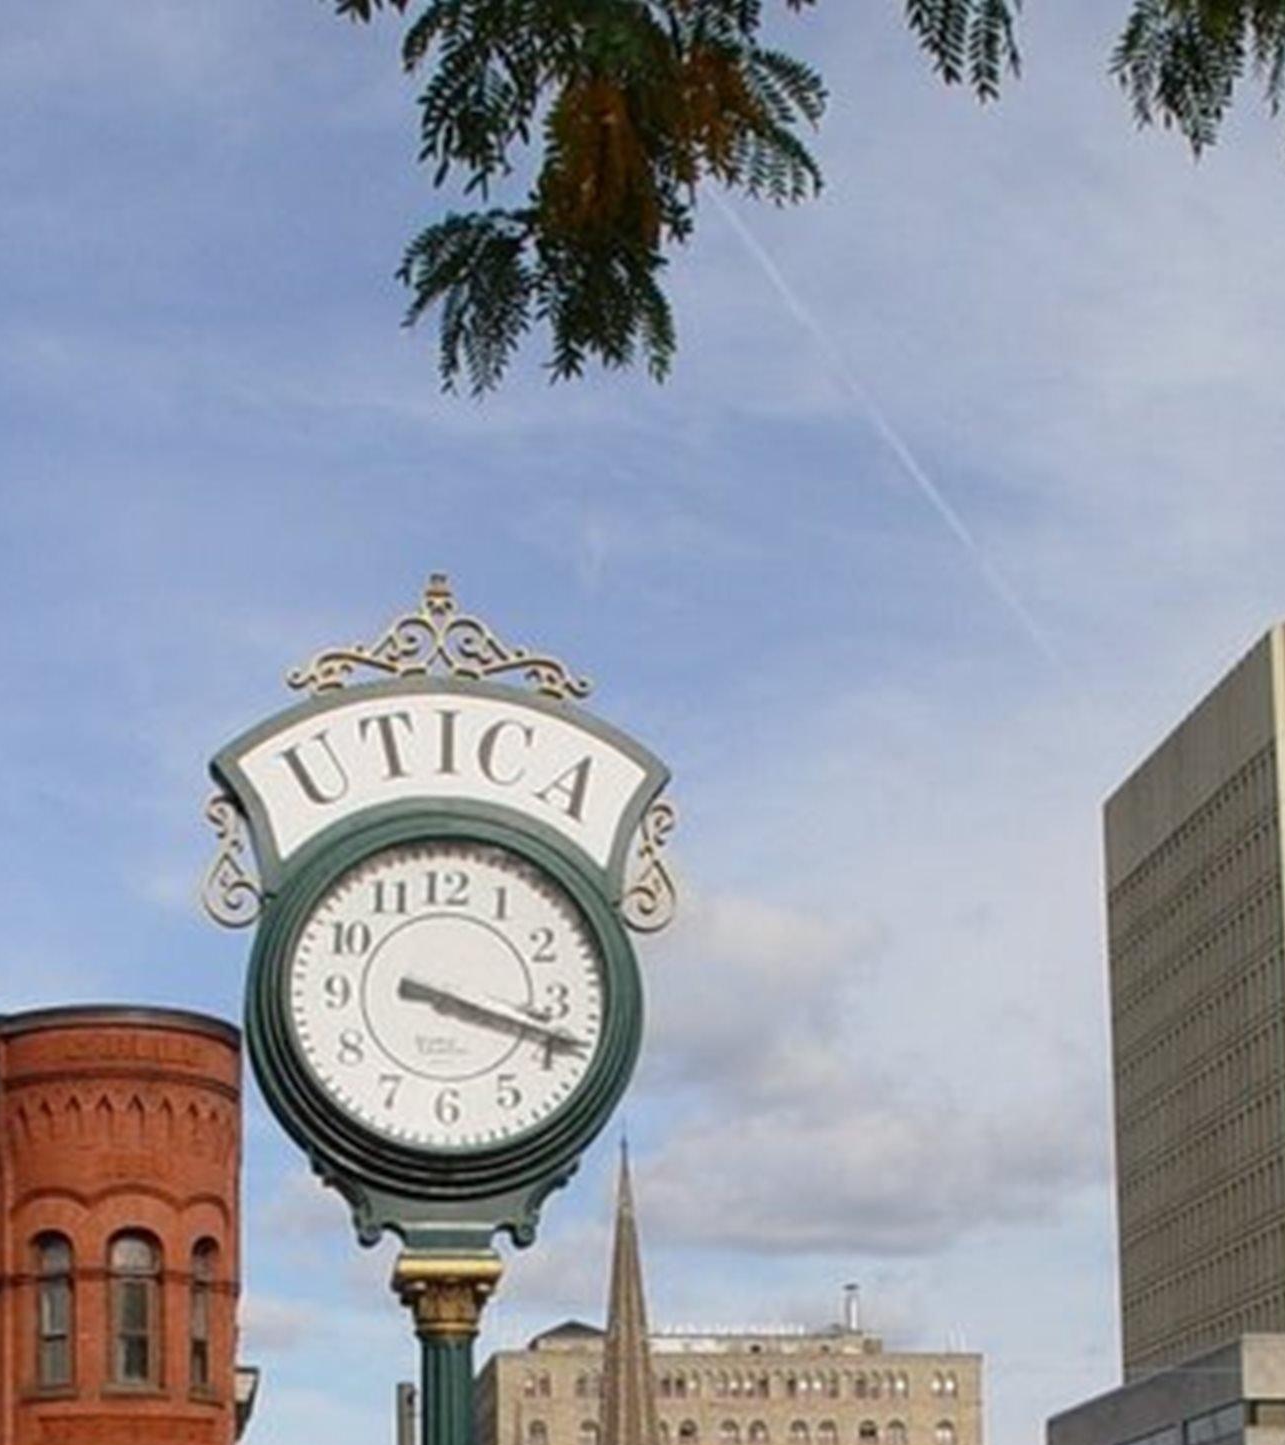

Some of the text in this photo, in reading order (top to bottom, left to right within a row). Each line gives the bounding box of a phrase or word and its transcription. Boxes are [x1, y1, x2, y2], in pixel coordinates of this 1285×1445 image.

[280, 709, 593, 823] UTICA
[372, 880, 408, 915] 11
[424, 870, 470, 906] 12
[493, 886, 507, 920] 1
[331, 920, 372, 955] 10
[529, 927, 557, 963] 2
[324, 974, 351, 1009] 9
[545, 983, 570, 1019] 3
[337, 1030, 364, 1066] 8
[378, 1073, 402, 1110] 7
[434, 1088, 460, 1126] 6
[496, 1074, 522, 1109] 5
